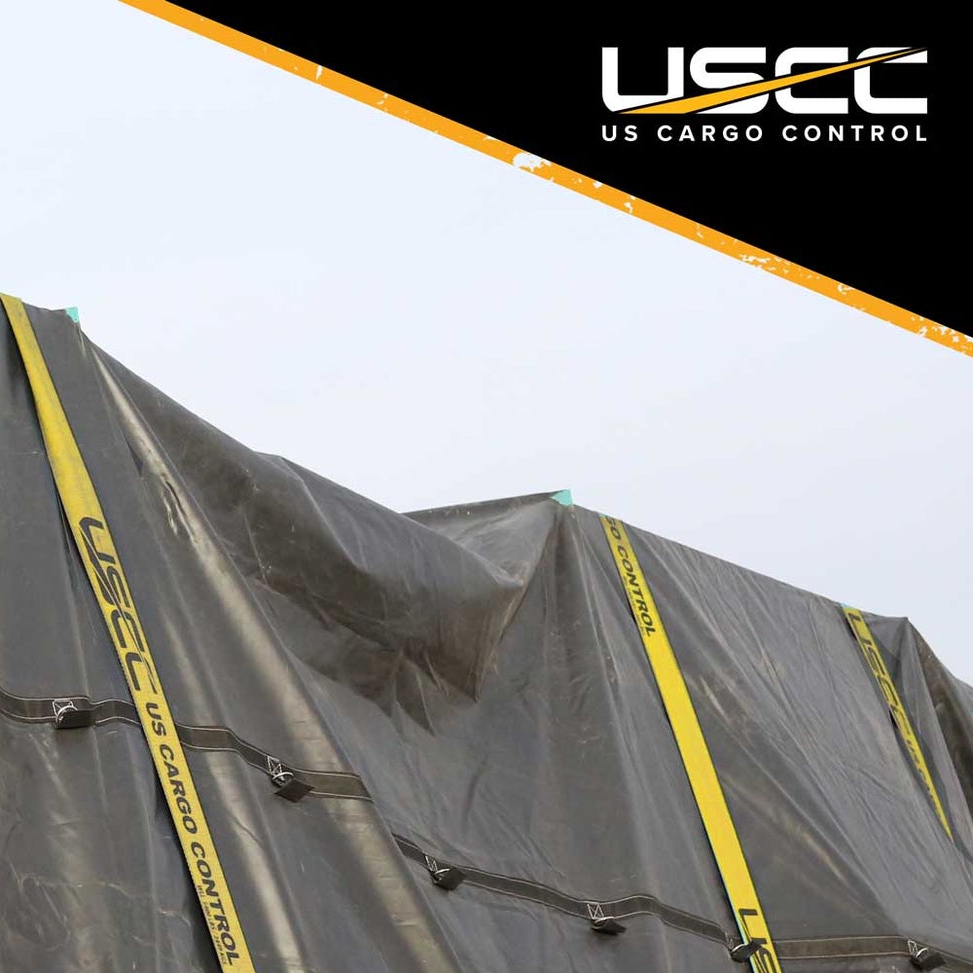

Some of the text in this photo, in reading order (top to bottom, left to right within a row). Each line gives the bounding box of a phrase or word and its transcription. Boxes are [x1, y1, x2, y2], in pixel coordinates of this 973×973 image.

[617, 545, 656, 637] CONTROL
[79, 516, 240, 966] USCC US CARGO CONTROL
